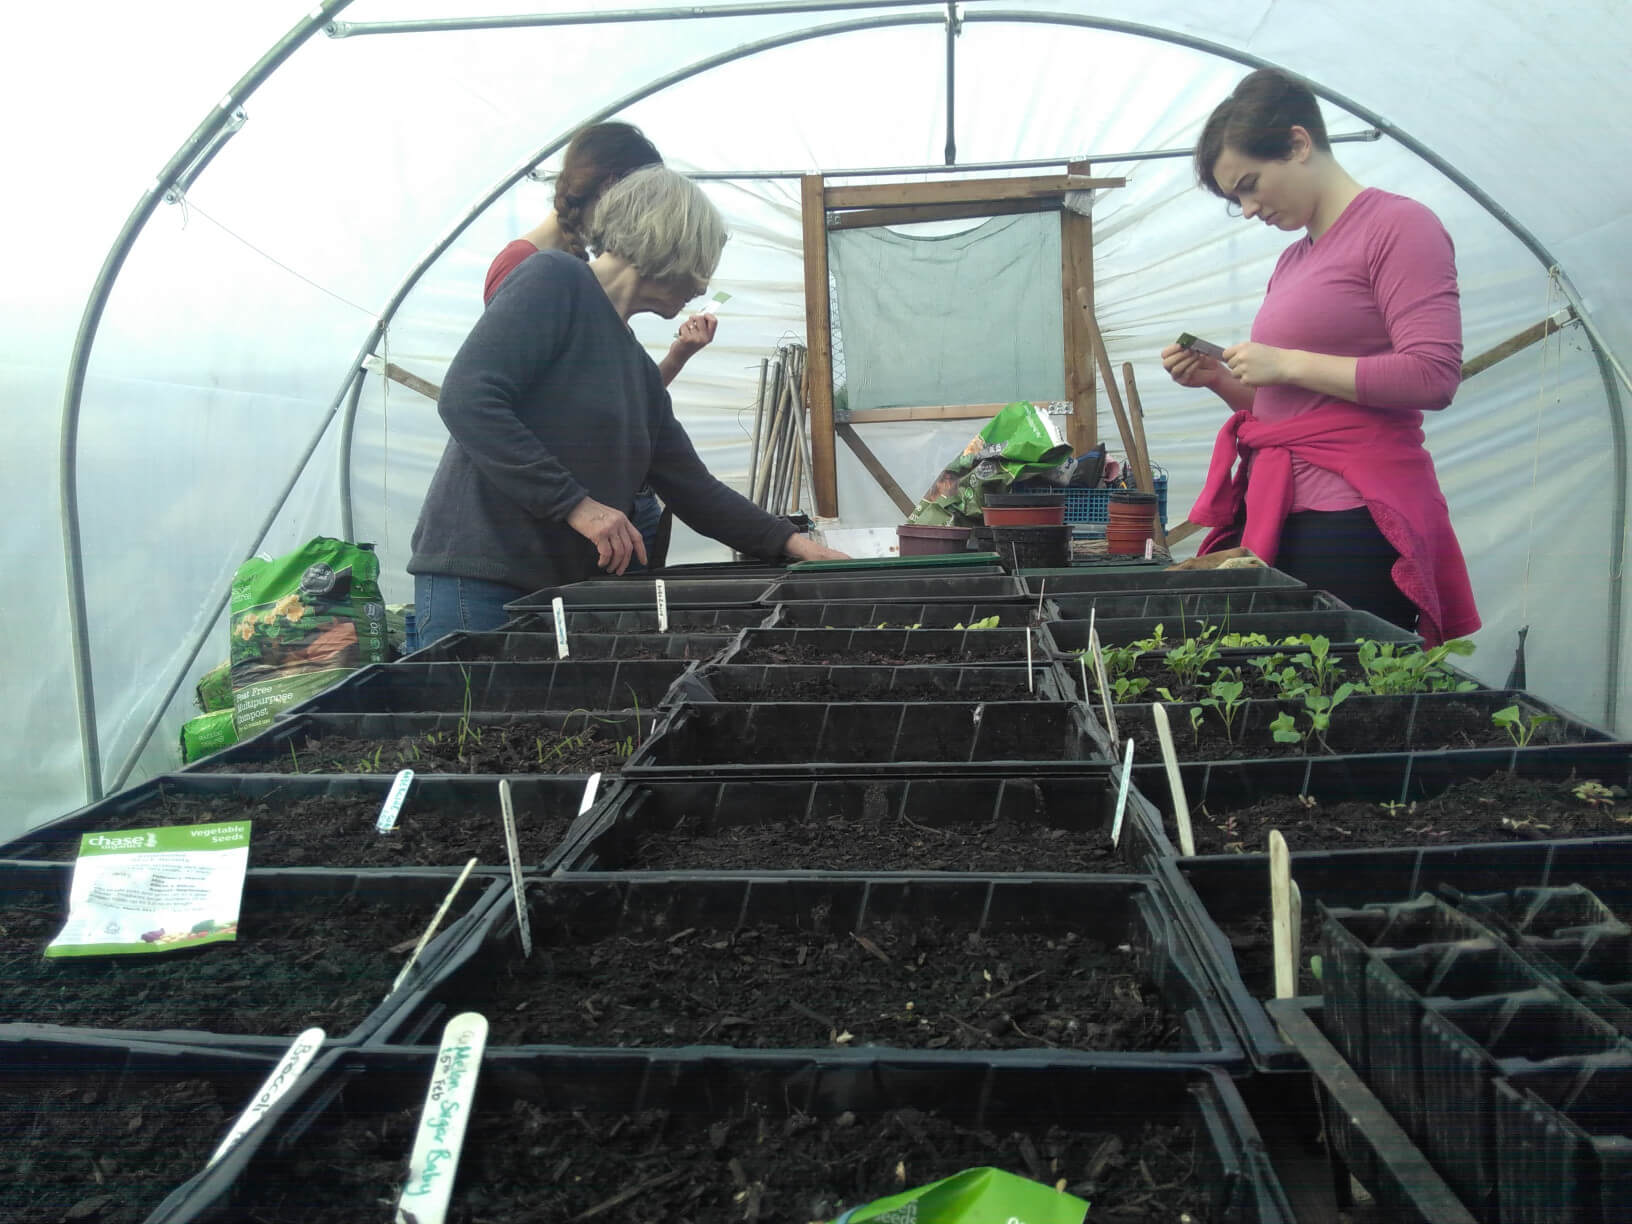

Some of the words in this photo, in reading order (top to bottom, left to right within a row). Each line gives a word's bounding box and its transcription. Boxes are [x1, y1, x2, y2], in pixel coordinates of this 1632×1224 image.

[251, 686, 273, 696] Free
[191, 826, 245, 837] Vegetable
[88, 836, 145, 846] chase
[212, 833, 244, 843] Seeds
[252, 1044, 312, 1112] Broccoli
[404, 1149, 452, 1196] Baby
